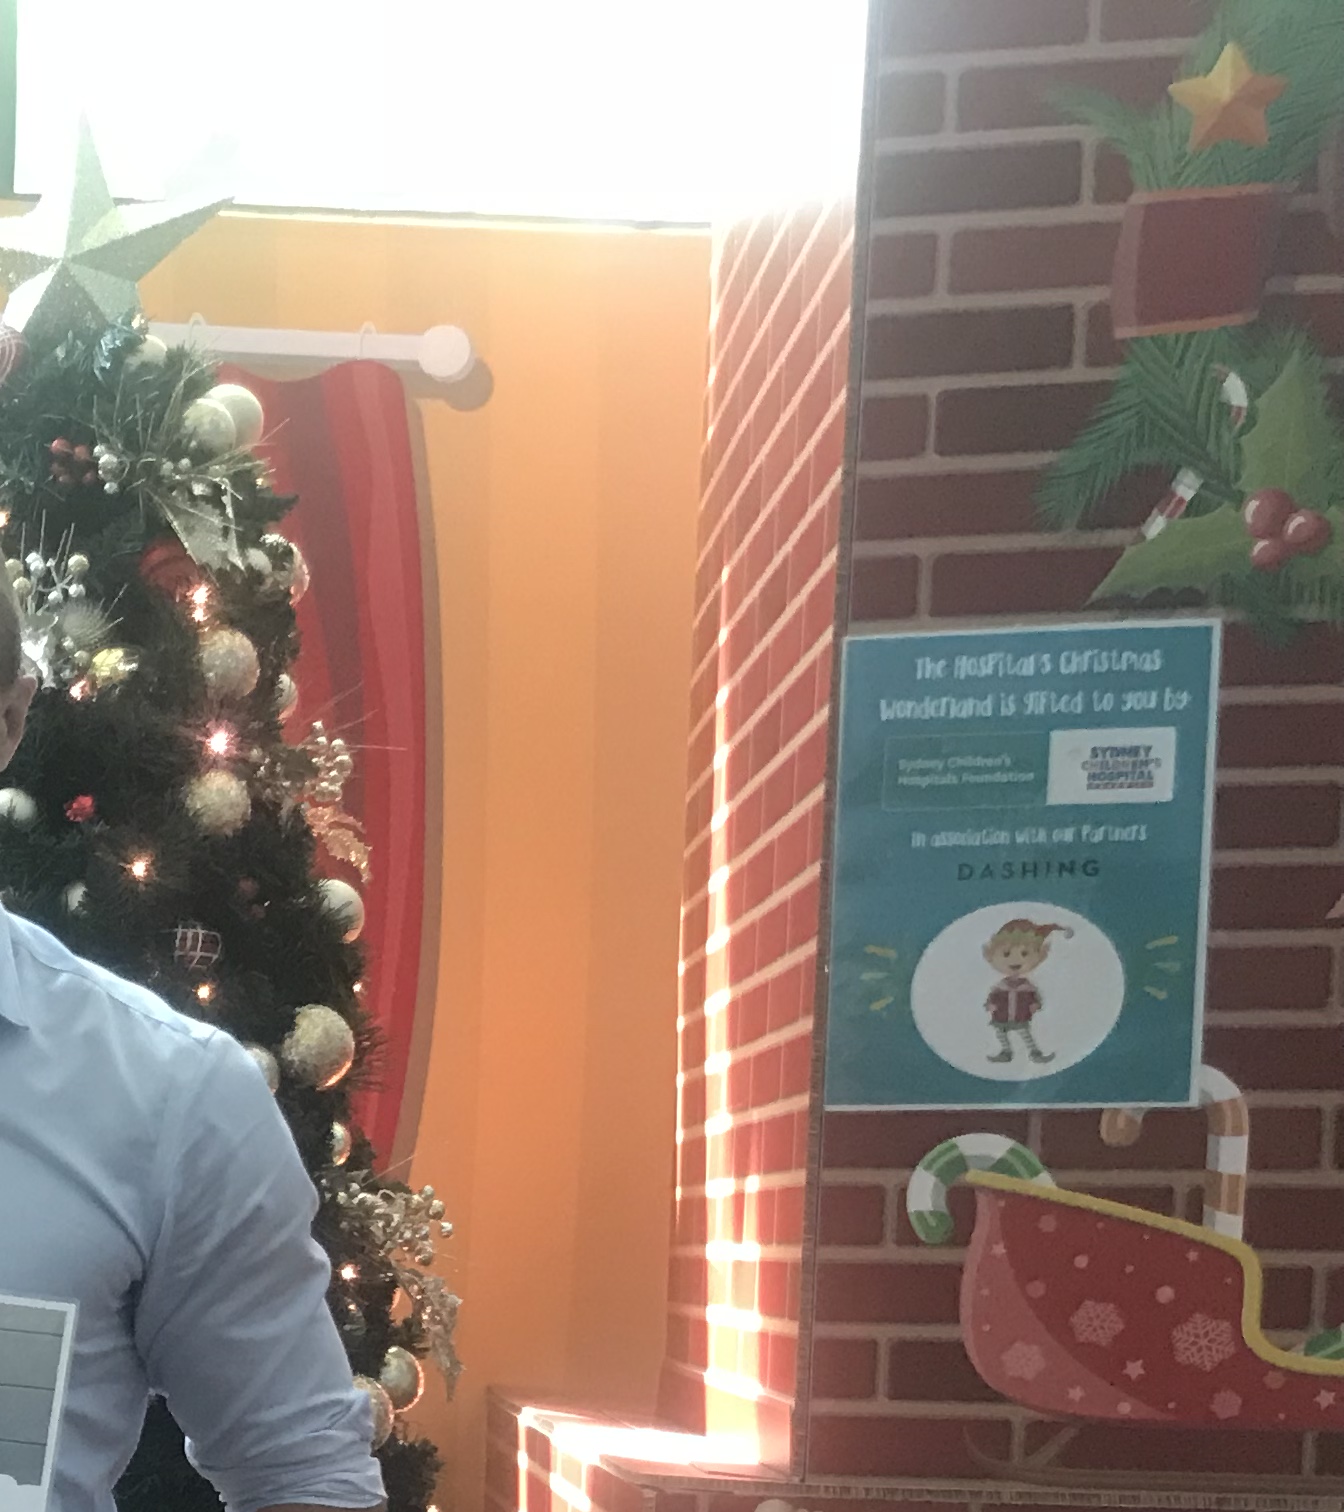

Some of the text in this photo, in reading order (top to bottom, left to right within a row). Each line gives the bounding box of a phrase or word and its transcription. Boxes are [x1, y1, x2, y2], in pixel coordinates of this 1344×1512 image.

[914, 657, 947, 679] The
[1059, 649, 1163, 674] Christmas
[1000, 692, 1016, 717] is
[1023, 690, 1083, 716] gifted
[1093, 689, 1114, 712] to
[1121, 688, 1157, 711] you
[898, 752, 1011, 774] Sydney Children's
[1090, 745, 1153, 759] SYDNEY
[961, 771, 1034, 785] Foundation
[1087, 770, 1154, 782] HOSPITAL
[911, 831, 925, 848] In
[930, 827, 1009, 848] association
[1015, 826, 1047, 845] with
[1052, 826, 1076, 844] our
[957, 858, 1100, 881] DASHING
